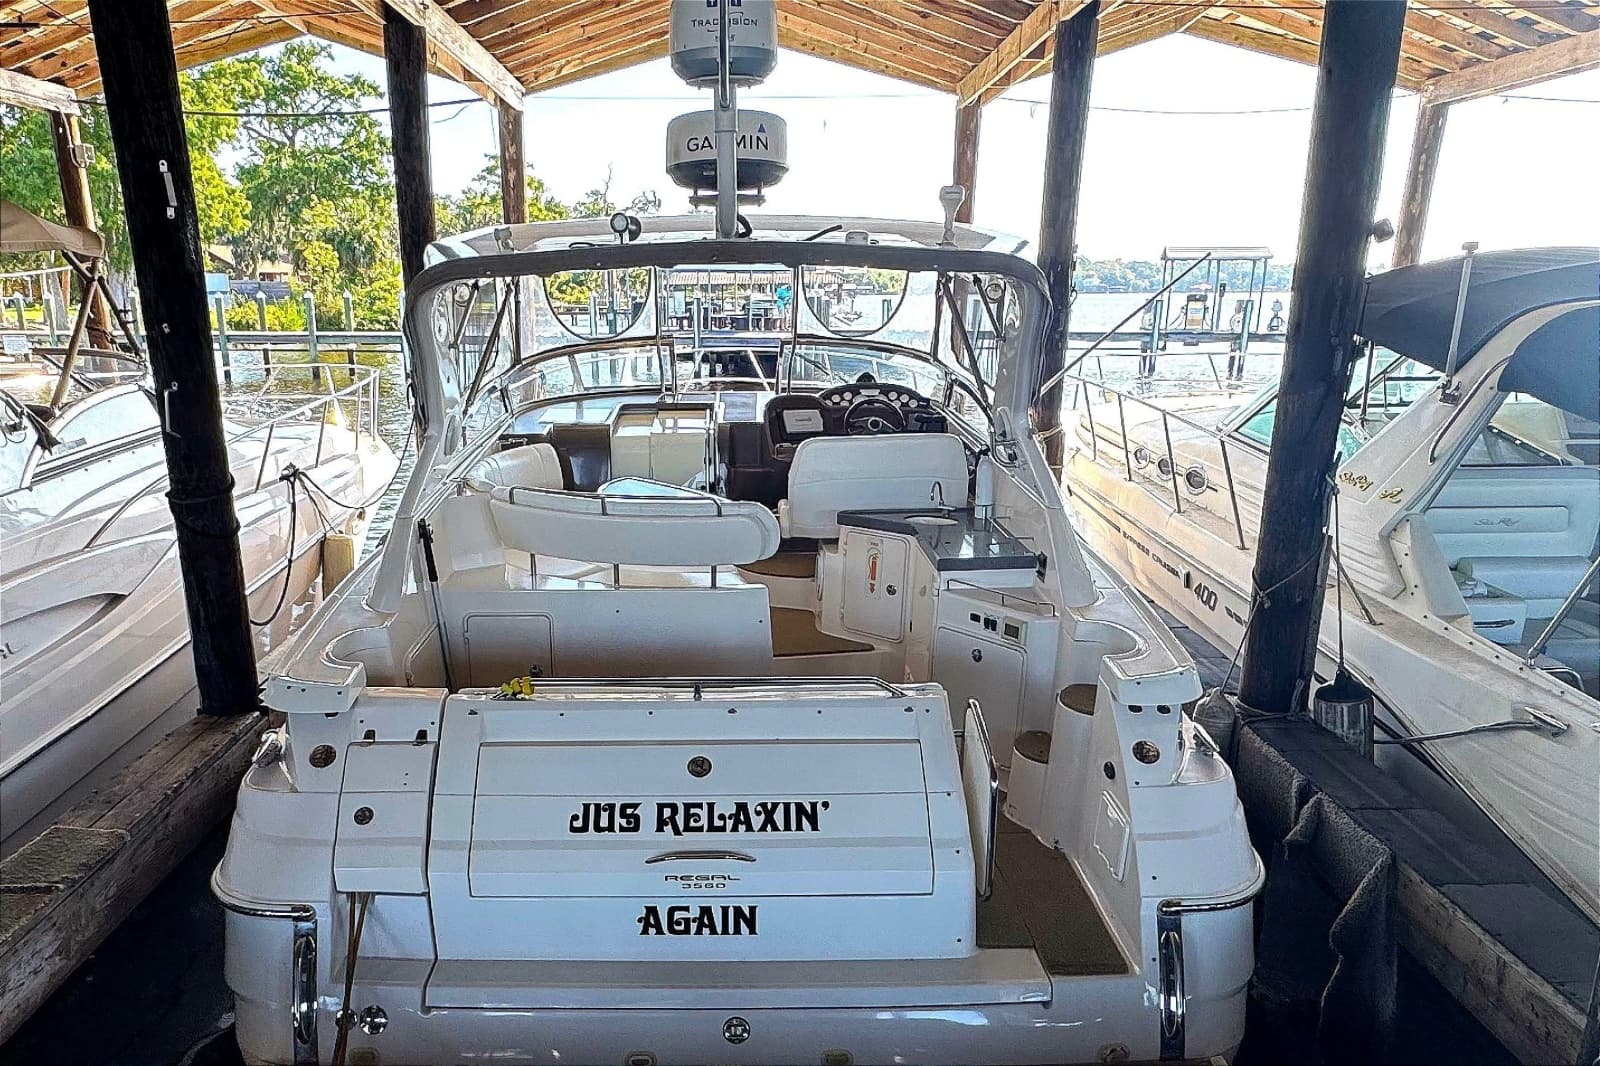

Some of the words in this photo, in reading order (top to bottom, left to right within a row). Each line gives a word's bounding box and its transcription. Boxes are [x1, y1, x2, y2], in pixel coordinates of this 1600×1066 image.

[1194, 582, 1218, 611] 400
[569, 801, 643, 834] JUS
[655, 800, 831, 837] RELAXIN'
[664, 874, 741, 882] REGAL
[637, 905, 759, 937] AGAIN
